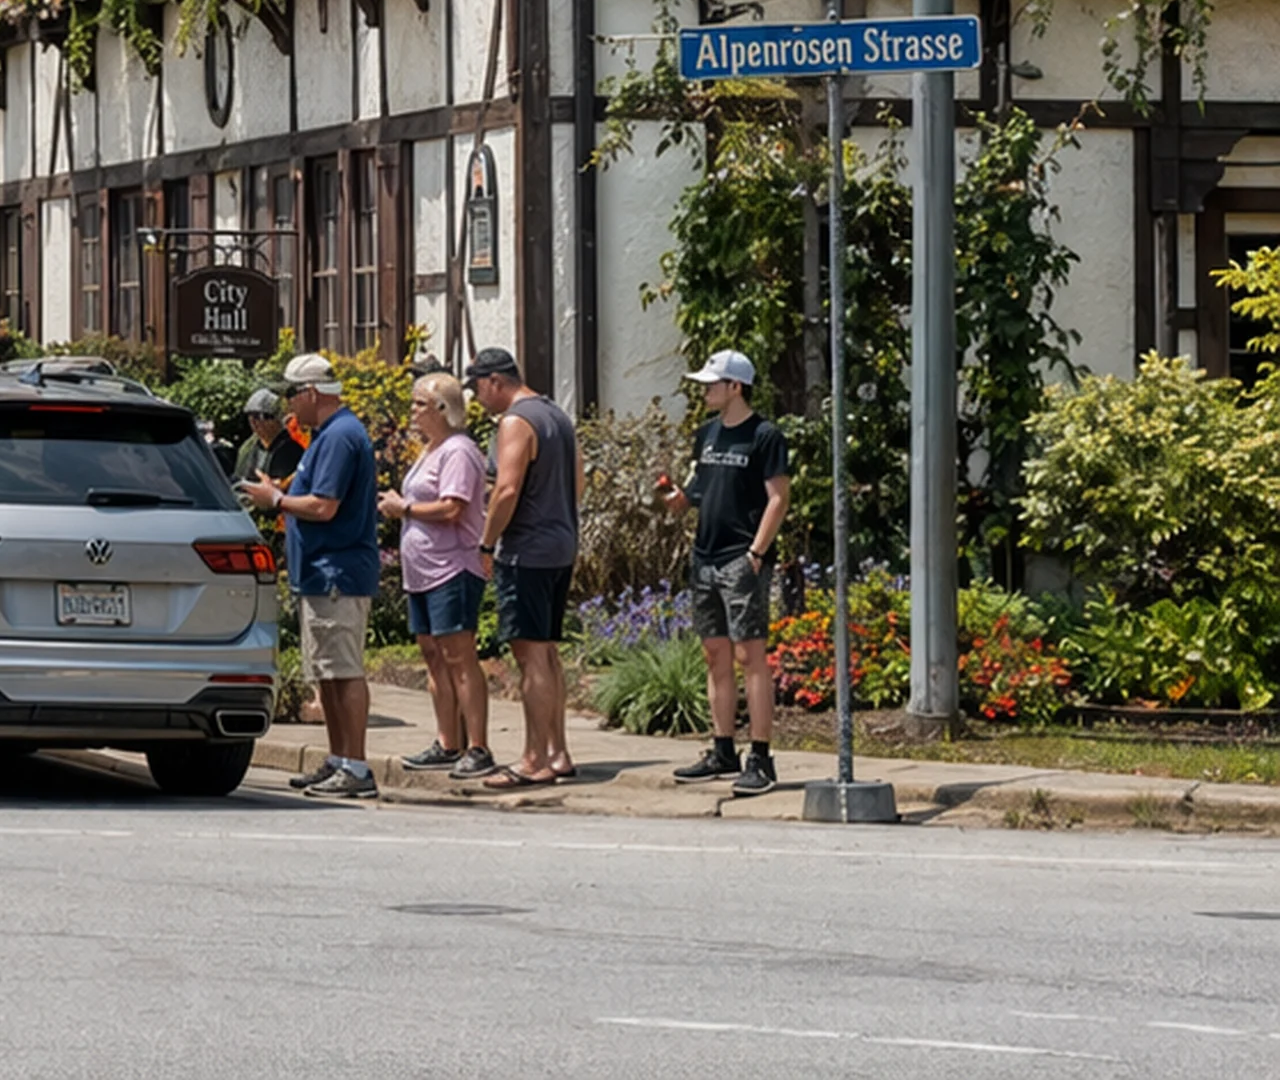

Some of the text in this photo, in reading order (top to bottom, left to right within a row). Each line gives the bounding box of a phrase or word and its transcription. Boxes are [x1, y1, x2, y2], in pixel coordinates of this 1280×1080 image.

[696, 28, 963, 76] Alpenrosen Strasse
[204, 280, 248, 308] City
